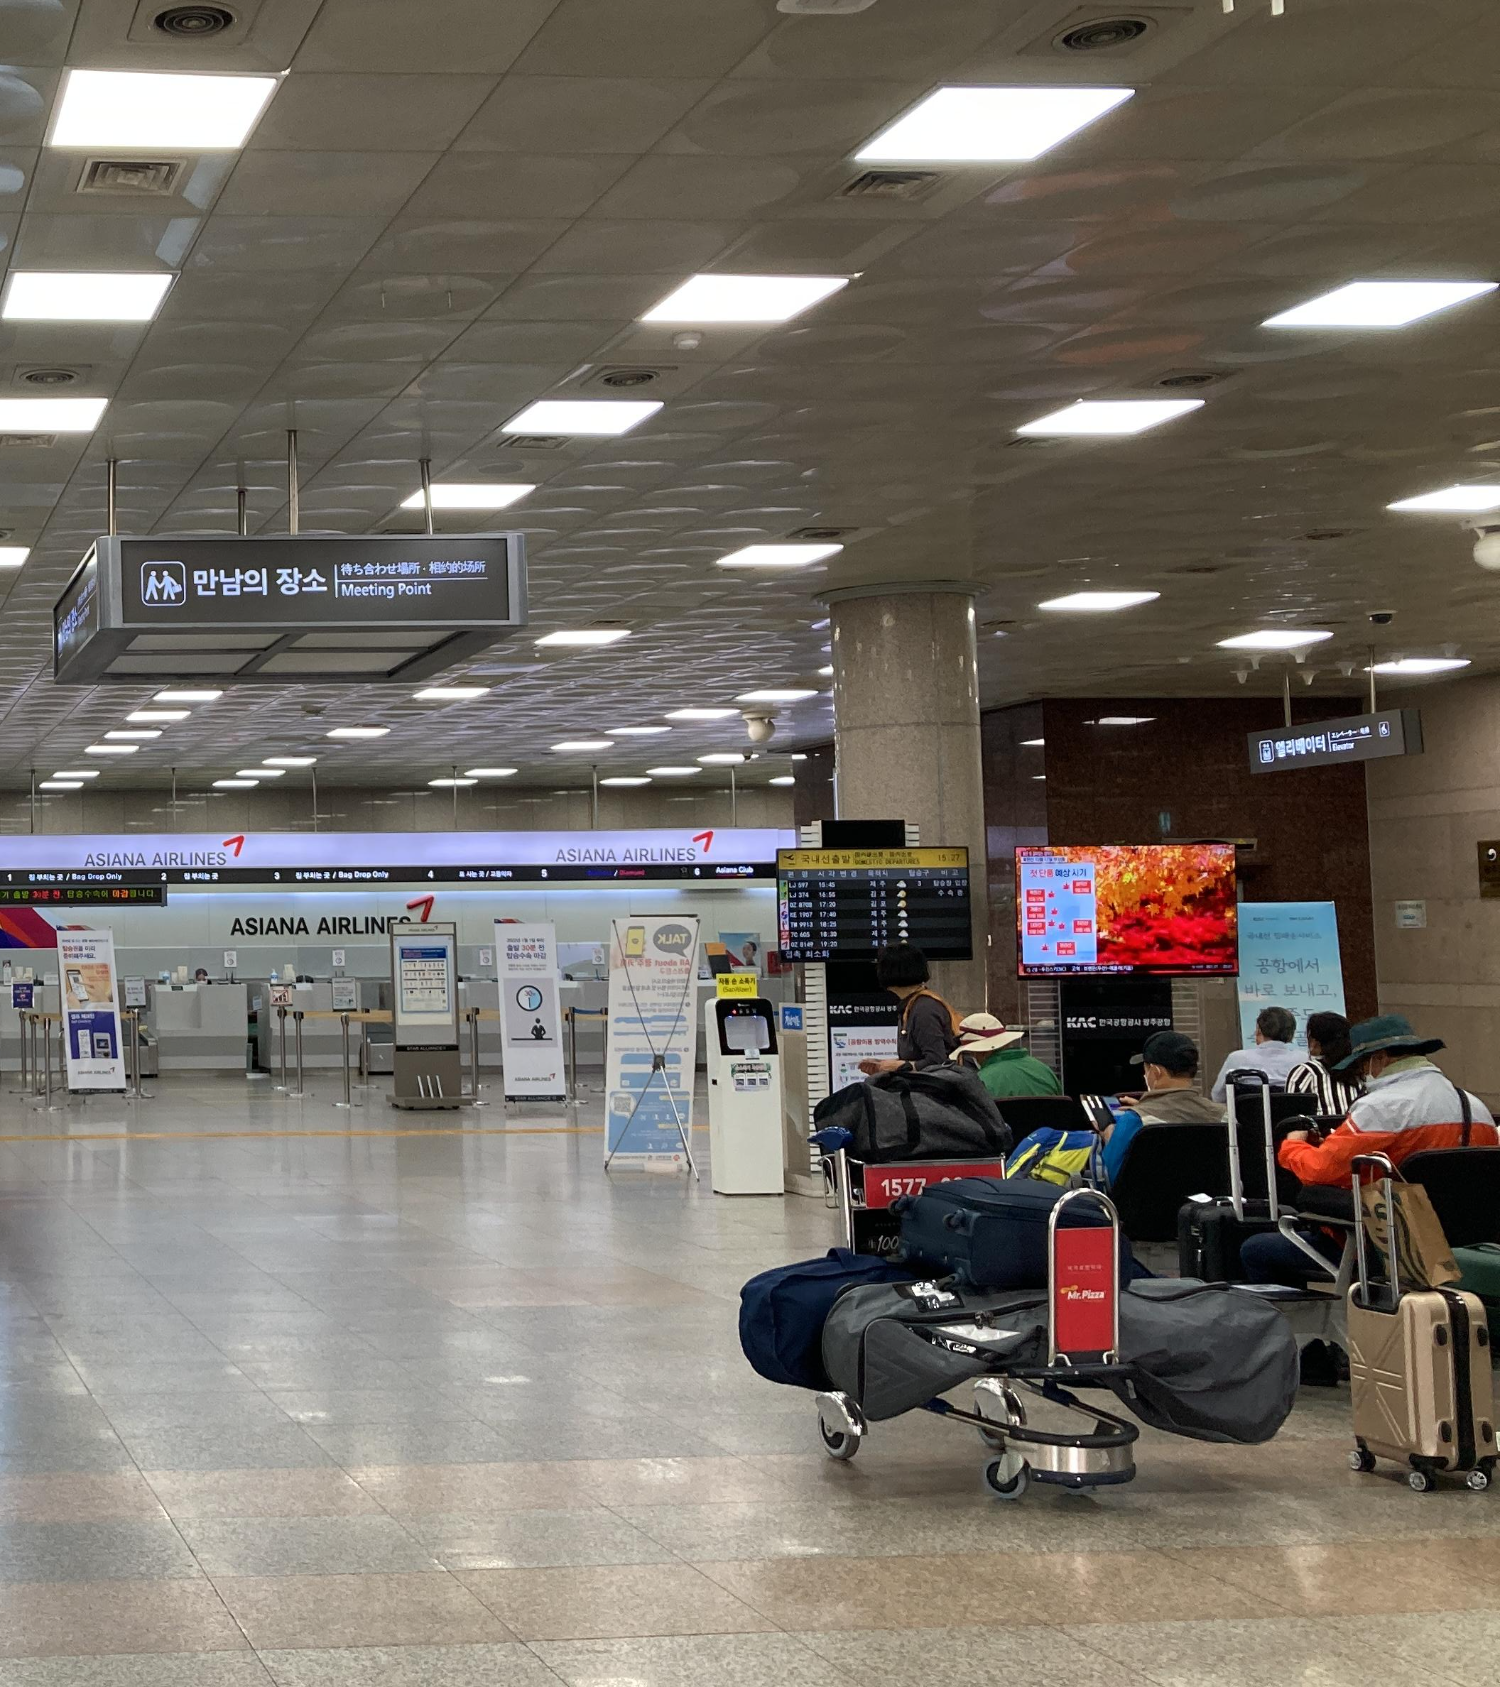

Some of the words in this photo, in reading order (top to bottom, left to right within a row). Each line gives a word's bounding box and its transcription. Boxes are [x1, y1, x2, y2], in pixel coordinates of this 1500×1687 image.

[193, 567, 268, 596] 만남의
[276, 566, 328, 596] 장소
[341, 582, 395, 598] Meeting
[398, 583, 432, 596] Point
[1275, 734, 1327, 758] 엘리베이터
[1332, 741, 1355, 751] Elevator
[84, 852, 146, 867] ASIANA
[152, 851, 227, 866] AIRLINES
[556, 848, 617, 862] ASIANA
[623, 847, 696, 862] AIRLINES
[801, 854, 851, 865] 국내선출발
[937, 853, 960, 861] 15:27
[274, 872, 280, 880] 3
[338, 871, 353, 879] Bag
[354, 871, 371, 879] Drop
[372, 870, 389, 879] Only
[428, 870, 434, 878] 4
[541, 868, 548, 877] 5
[694, 867, 700, 876] 6
[716, 866, 737, 874] Asiana
[738, 866, 754, 874] Club
[1055, 868, 1070, 878] 예상
[1072, 868, 1087, 877] 시기
[7, 873, 13, 881] 1
[72, 873, 86, 881] Bag
[88, 873, 104, 881] Drop
[106, 873, 122, 881] Only
[161, 872, 167, 881] 2
[13, 890, 29, 899] 출발
[231, 917, 309, 935] ASIANA
[317, 916, 411, 935] AIRLIN
[1255, 958, 1320, 974] 공항에서
[1245, 982, 1277, 997] 바로
[1283, 982, 1337, 998] 보내고,
[830, 1005, 852, 1014] KAC
[1067, 1017, 1096, 1028] KAC
[1099, 1018, 1142, 1027] 한국공항공사
[1143, 1018, 1171, 1027] 광주공항
[881, 1178, 926, 1197] 1577
